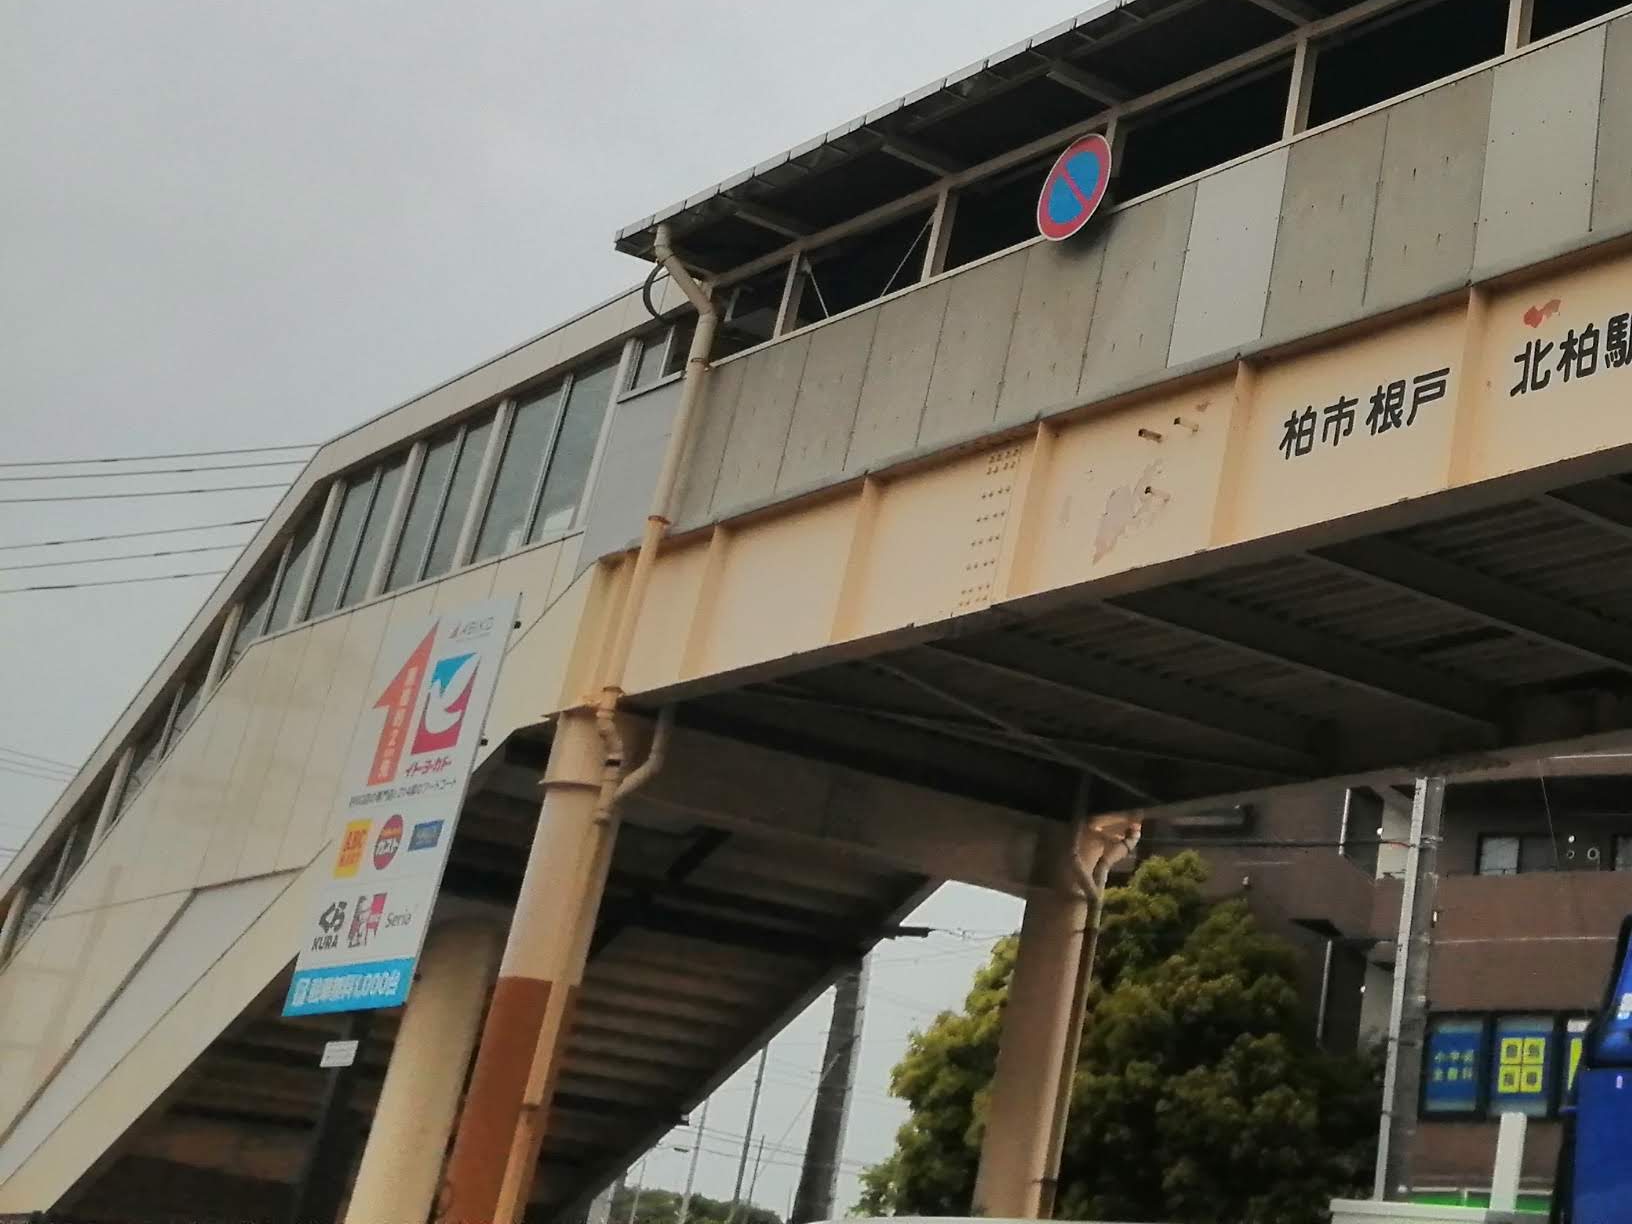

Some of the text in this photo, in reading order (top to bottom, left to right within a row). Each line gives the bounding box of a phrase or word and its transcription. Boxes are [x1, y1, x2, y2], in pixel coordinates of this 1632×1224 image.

[1277, 367, 1452, 461] 柏市根戸
[385, 907, 412, 929] Seria
[311, 934, 339, 952] KURA
